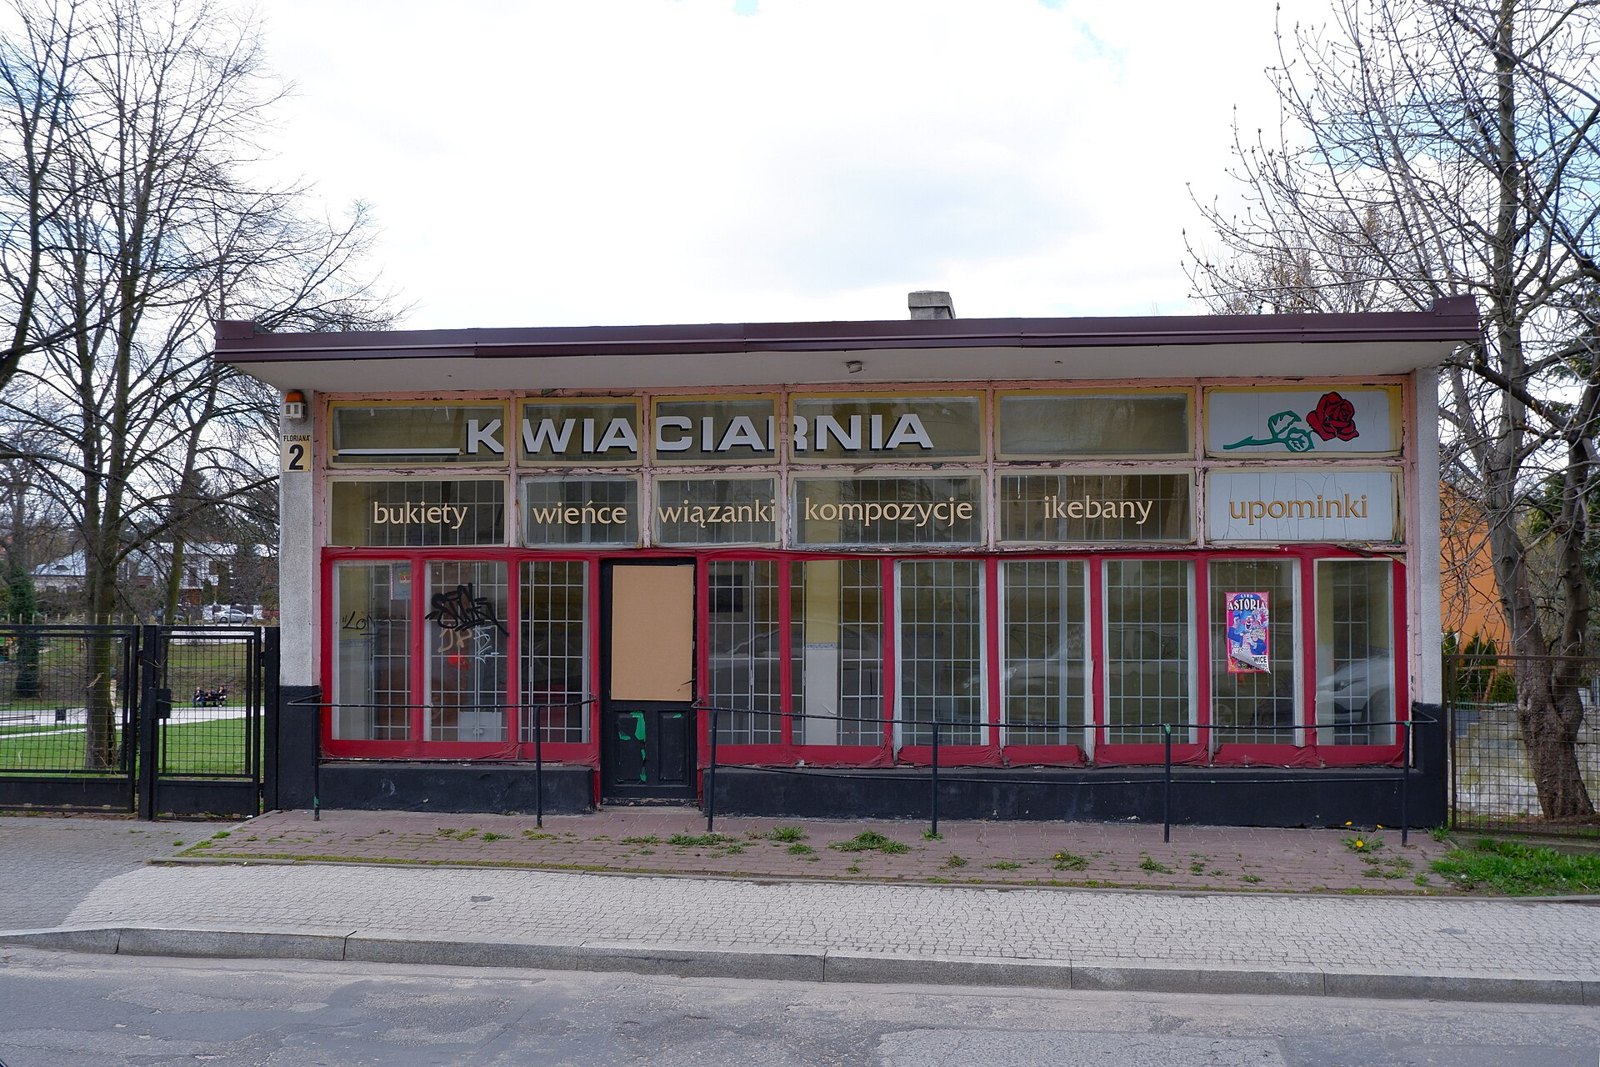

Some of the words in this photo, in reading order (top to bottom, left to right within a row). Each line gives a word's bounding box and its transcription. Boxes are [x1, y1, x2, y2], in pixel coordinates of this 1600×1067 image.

[289, 444, 304, 470] 2
[373, 501, 468, 530] bukiety
[533, 501, 627, 525] wieńce
[657, 499, 776, 528] wiązanki
[804, 497, 973, 527] kompozycje
[1043, 496, 1153, 525] ikebany
[1229, 494, 1368, 525] upominki
[1228, 599, 1266, 611] ASTORIA
